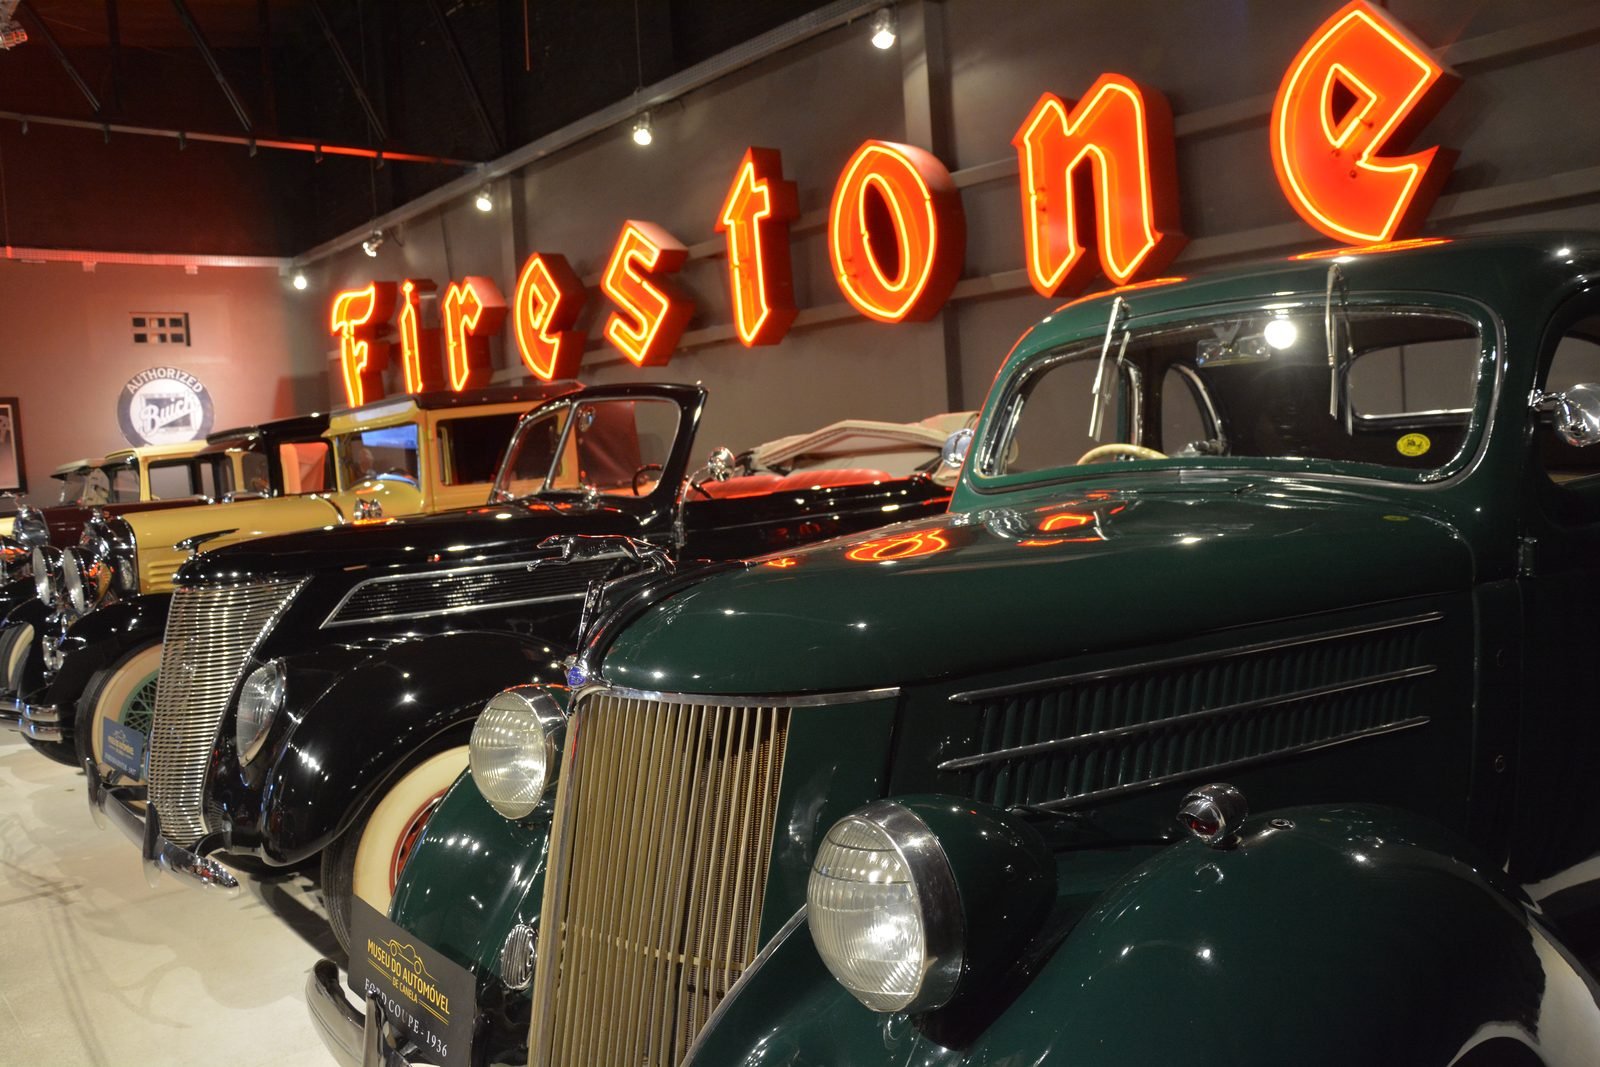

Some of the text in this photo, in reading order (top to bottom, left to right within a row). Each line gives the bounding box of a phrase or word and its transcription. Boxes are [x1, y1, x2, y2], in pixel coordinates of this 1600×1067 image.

[330, 0, 1450, 408] Firestone
[126, 367, 204, 395] AUTHORIZED
[140, 389, 198, 437] Buick
[367, 938, 450, 1015] MUSEU DO AUTOMÓVEL
[392, 976, 418, 1004] DE CANELA
[388, 999, 419, 1034] COUPE
[426, 1030, 448, 1057] 1936
